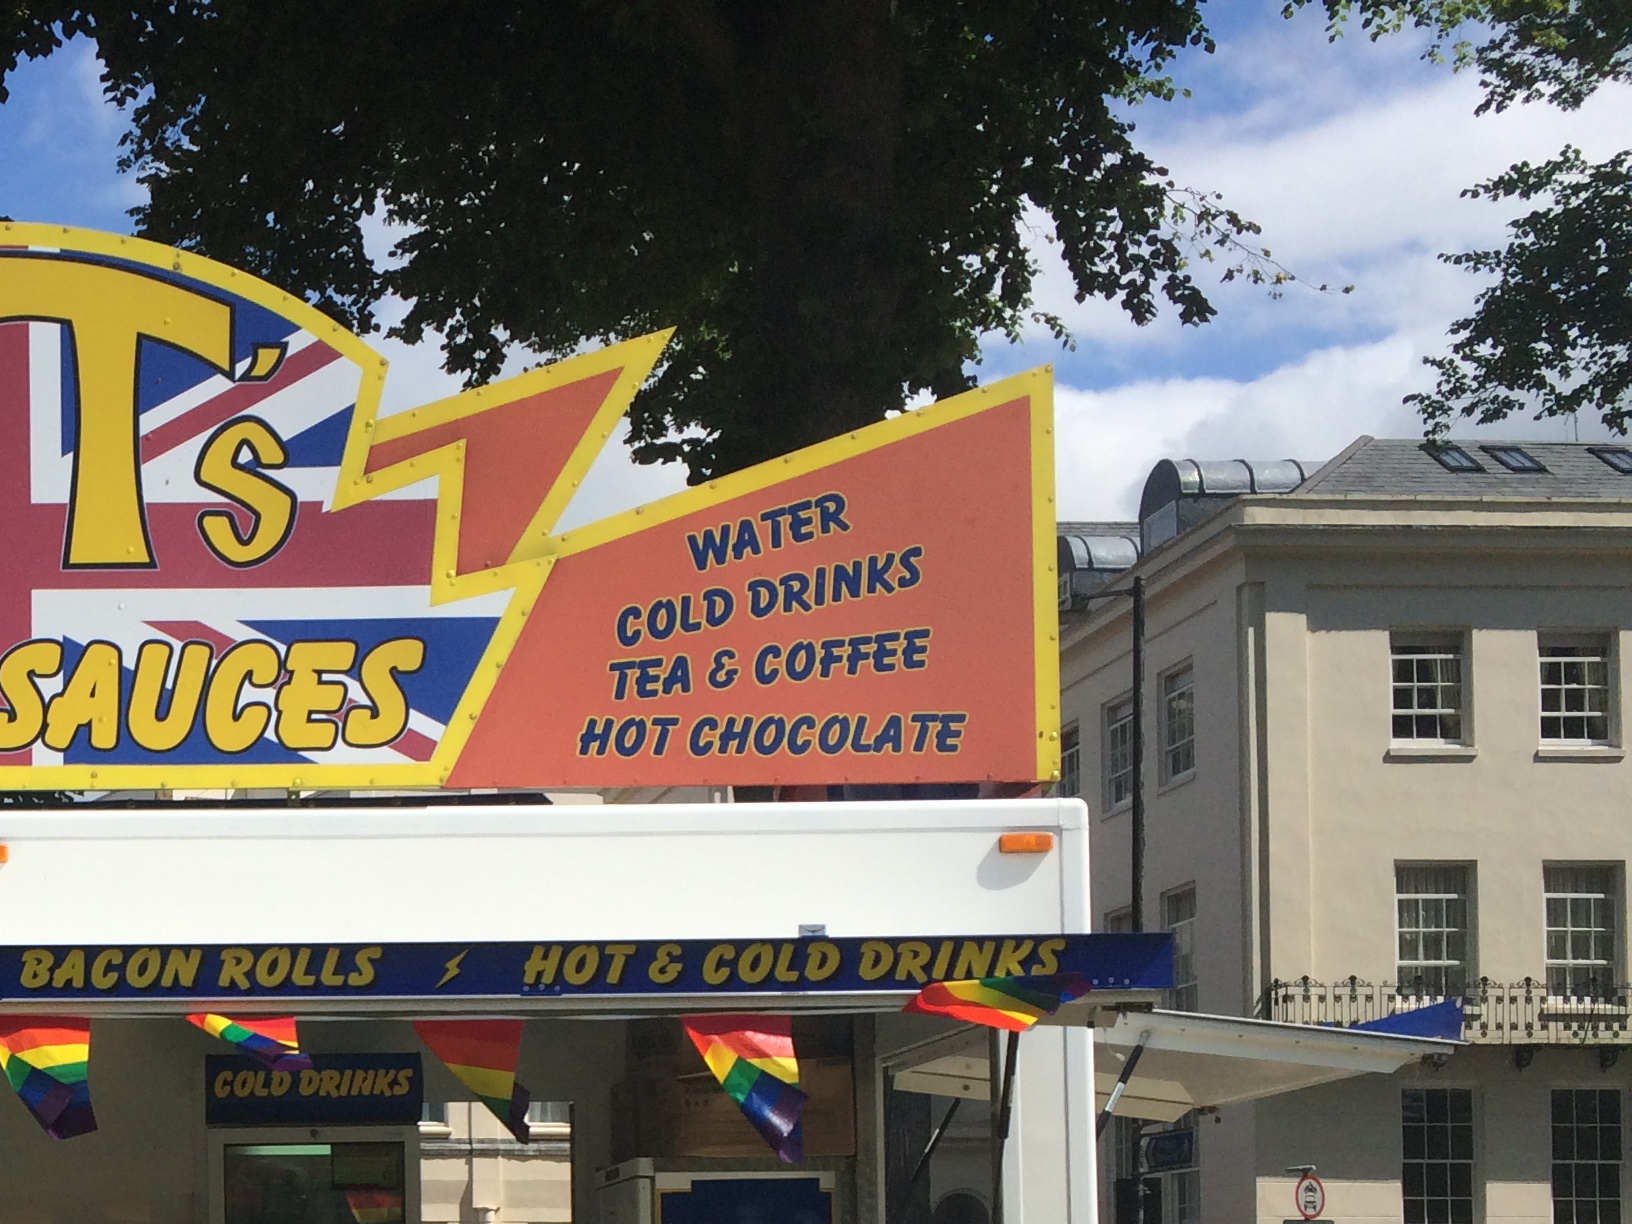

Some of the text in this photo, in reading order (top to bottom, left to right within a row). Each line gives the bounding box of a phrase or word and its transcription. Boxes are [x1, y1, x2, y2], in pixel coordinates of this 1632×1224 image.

[686, 490, 852, 572] WATER
[616, 545, 924, 648] COLD DRINKS
[607, 628, 932, 702] TEA & COFFEE
[578, 713, 968, 758] HOT CHOCOLATE
[19, 946, 382, 992] BACON ROLLS
[523, 938, 1066, 986] HOT & COLD DRINKS
[214, 1068, 414, 1099] COLD DRINKS
